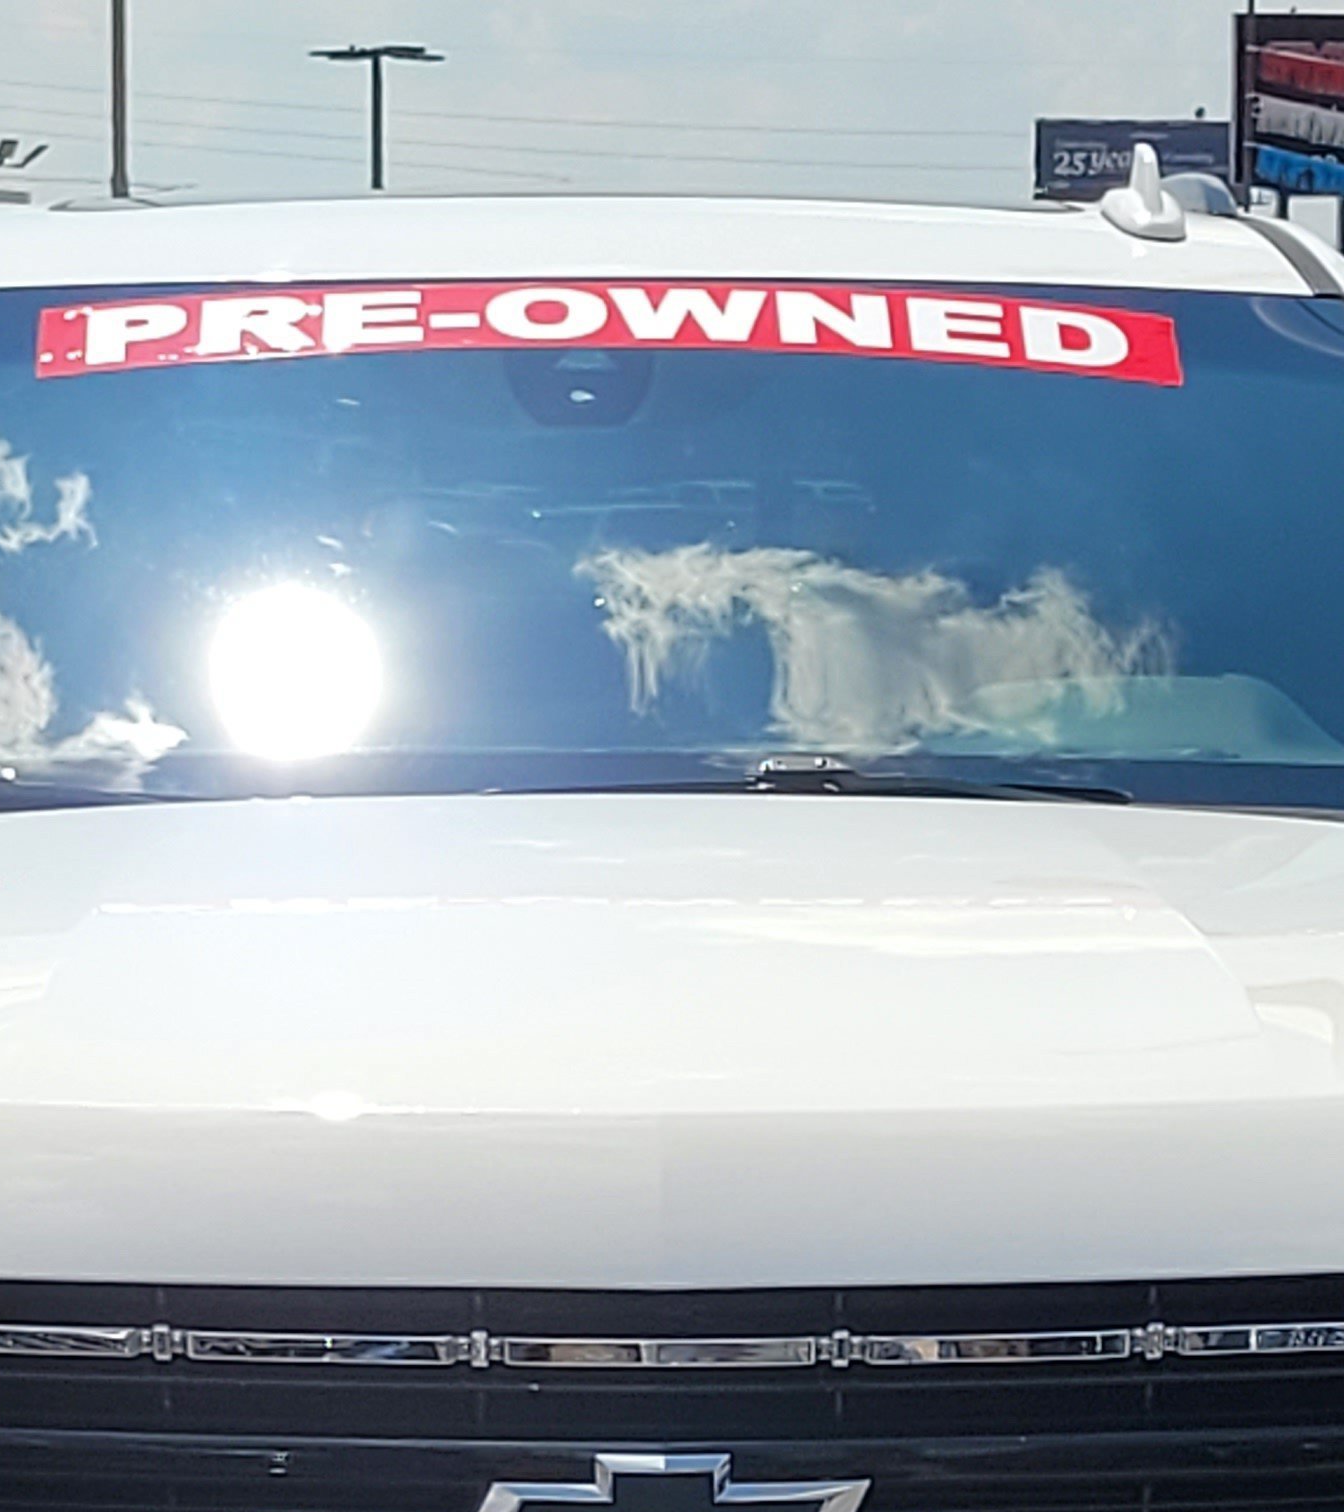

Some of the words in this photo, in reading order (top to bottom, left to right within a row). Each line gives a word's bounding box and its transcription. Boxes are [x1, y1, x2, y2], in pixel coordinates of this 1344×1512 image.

[1053, 150, 1086, 176] 25
[1088, 150, 1134, 175] yea
[83, 286, 1129, 368] PRE-OWNED
